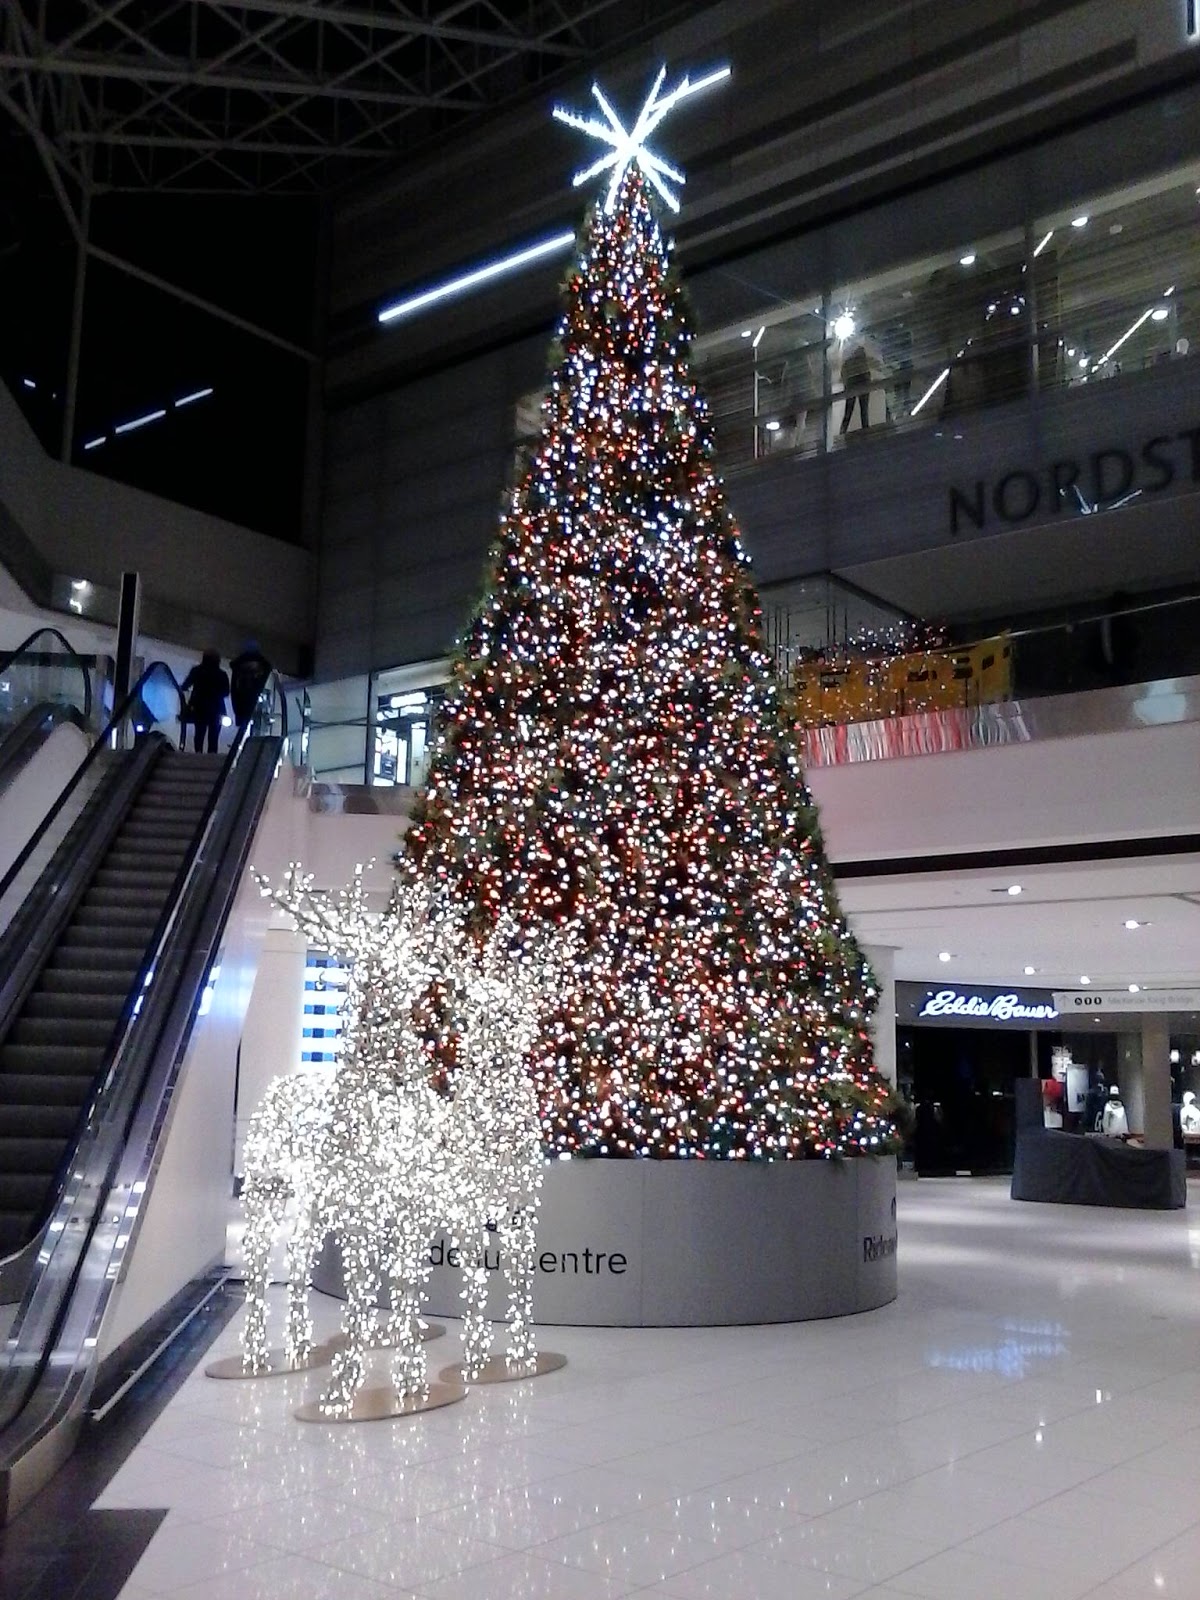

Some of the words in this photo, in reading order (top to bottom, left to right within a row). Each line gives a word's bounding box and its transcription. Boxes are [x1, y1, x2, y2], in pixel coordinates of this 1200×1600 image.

[920, 991, 990, 1016] Eddie
[986, 994, 1059, 1019] Bauer
[529, 1248, 627, 1275] entre
